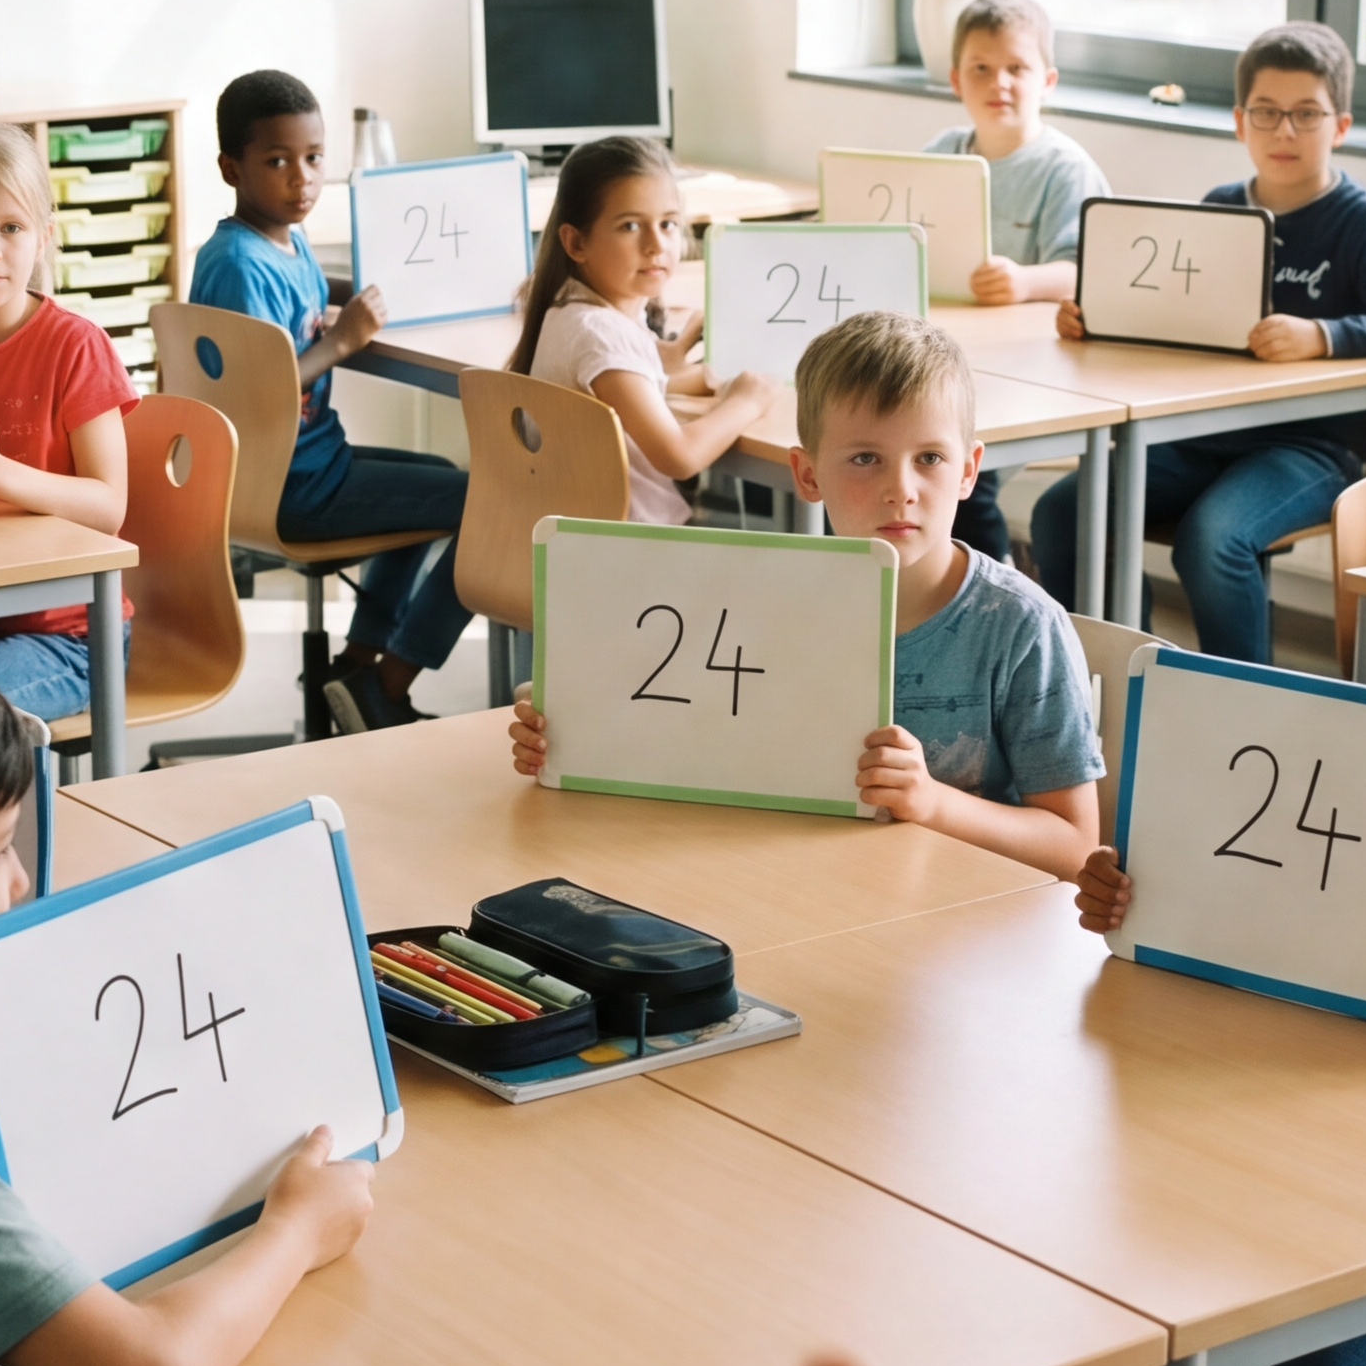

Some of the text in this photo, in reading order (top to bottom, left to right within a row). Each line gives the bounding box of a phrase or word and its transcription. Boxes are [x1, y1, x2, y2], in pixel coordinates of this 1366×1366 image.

[403, 202, 469, 266] 24
[1129, 235, 1202, 295] 24
[766, 262, 854, 324] 24
[630, 604, 766, 717] 24
[1213, 744, 1362, 892] 24
[94, 952, 246, 1122] 24
